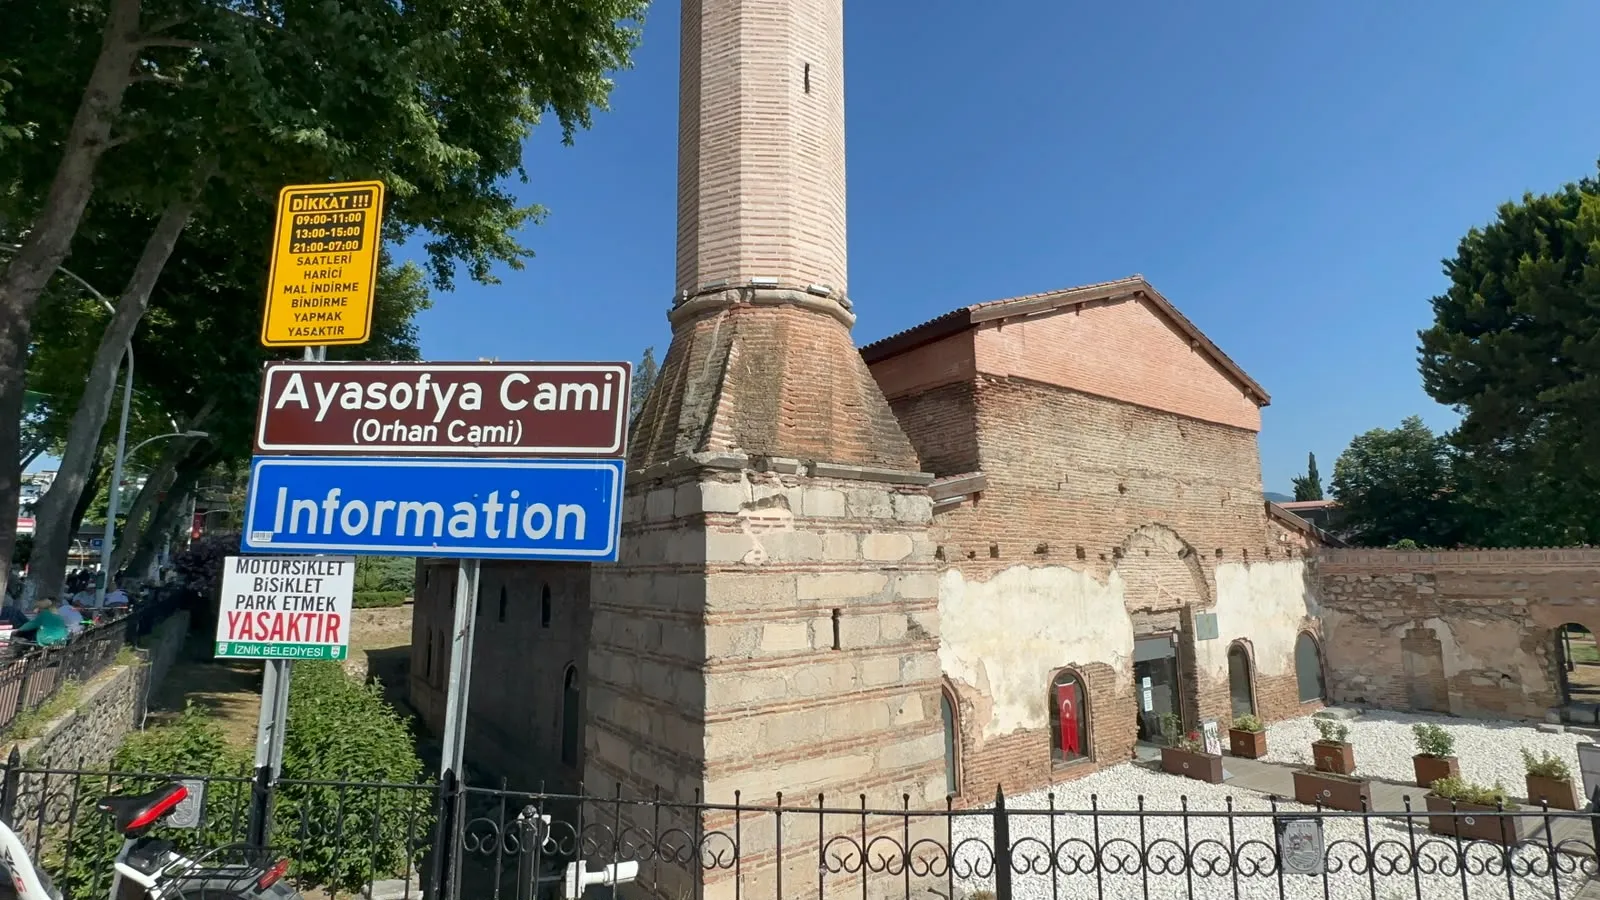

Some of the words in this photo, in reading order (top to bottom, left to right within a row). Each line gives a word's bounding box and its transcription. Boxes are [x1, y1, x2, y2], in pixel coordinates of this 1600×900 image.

[293, 195, 349, 211] DİKKAT
[352, 194, 369, 208] !!!
[296, 212, 362, 225] 09:00-11:00
[295, 226, 361, 239] 13:00-15:00
[293, 240, 359, 253] 21:00-07:00
[296, 252, 352, 266] SAATLERİ
[303, 266, 343, 280] HARİCİ
[283, 284, 307, 294] MAL
[310, 281, 359, 294] İNDİRME
[291, 296, 348, 308] BİNDİRME
[294, 311, 342, 322] YAPMAK
[288, 325, 345, 337] YASAKTIR
[274, 372, 482, 423] Ayasofya
[499, 372, 613, 412] Cami
[353, 418, 438, 444] (Orhan
[447, 419, 523, 446] Cami)
[273, 487, 586, 541] Information
[235, 594, 277, 611] PARK
[282, 595, 337, 612] ETMEK
[227, 611, 341, 643] YASAKTIR
[234, 644, 260, 656] İZNİK
[263, 645, 324, 657] BELEDİYESİ
